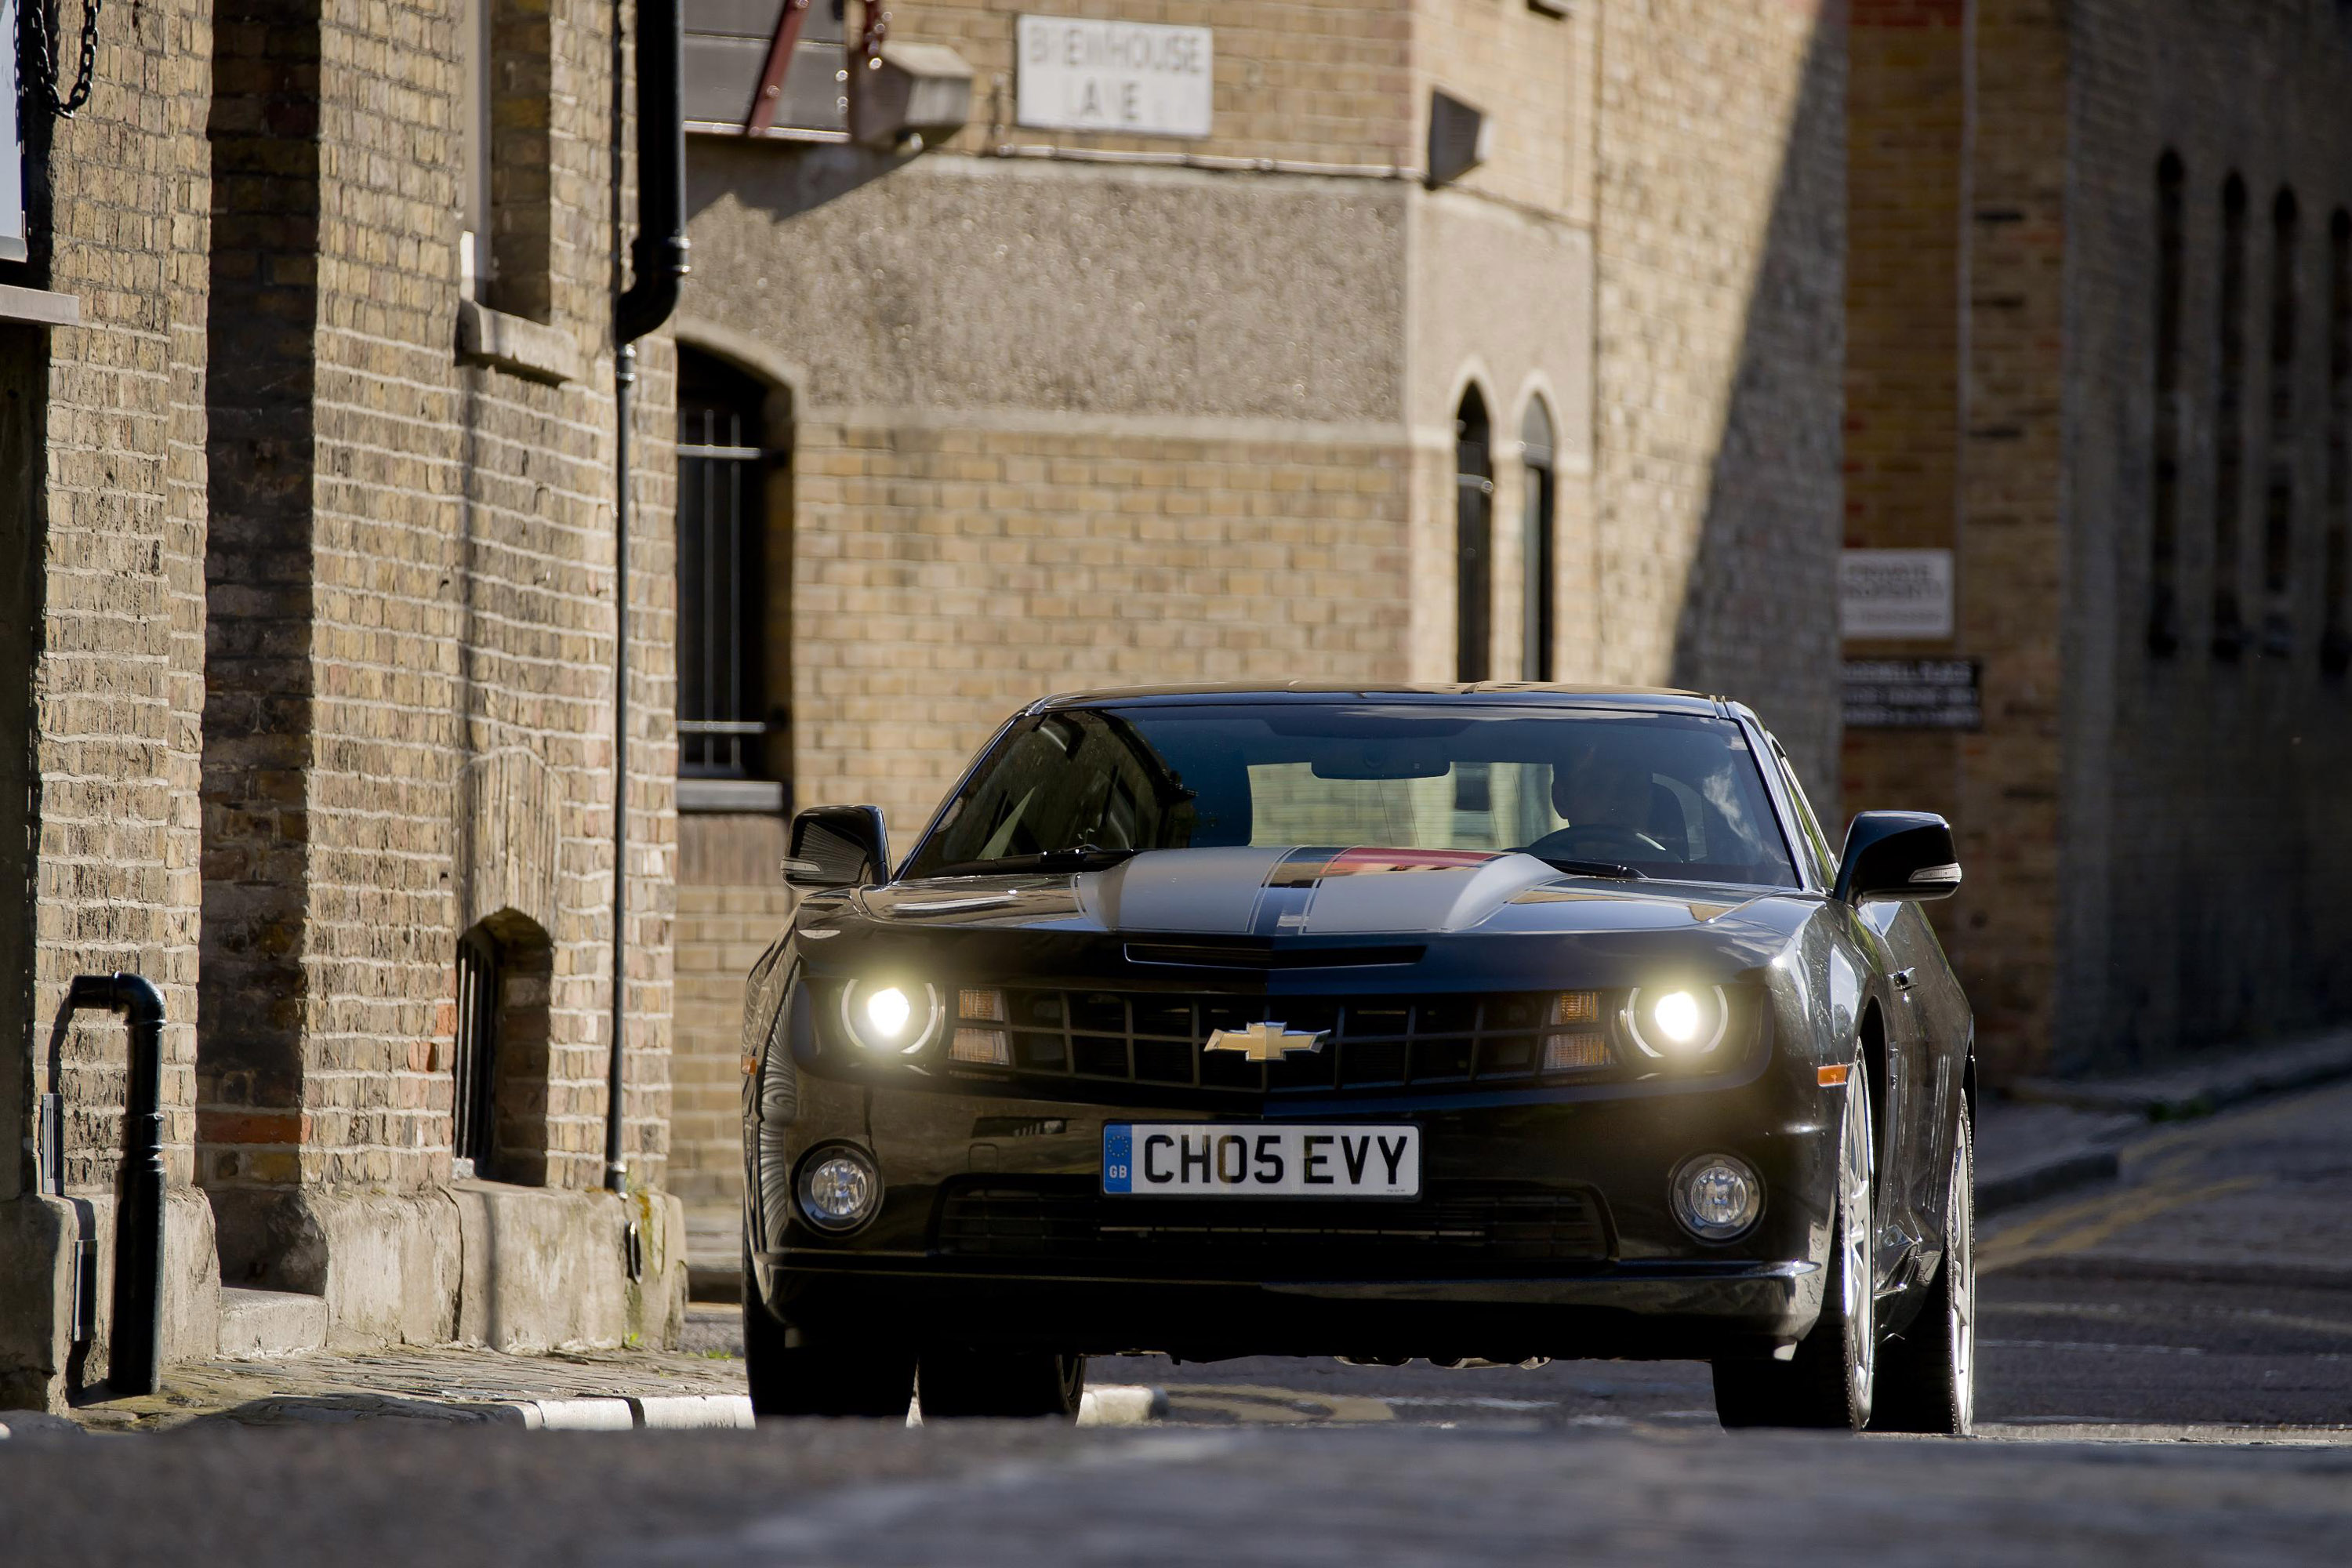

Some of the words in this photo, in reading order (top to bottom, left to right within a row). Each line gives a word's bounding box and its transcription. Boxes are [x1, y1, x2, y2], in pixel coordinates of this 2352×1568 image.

[1029, 24, 1203, 74] BEHOUSE
[1063, 78, 1141, 121] AE
[1109, 1165, 1127, 1178] GB
[1145, 1134, 1284, 1184] CH05
[1304, 1135, 1408, 1185] EVY
